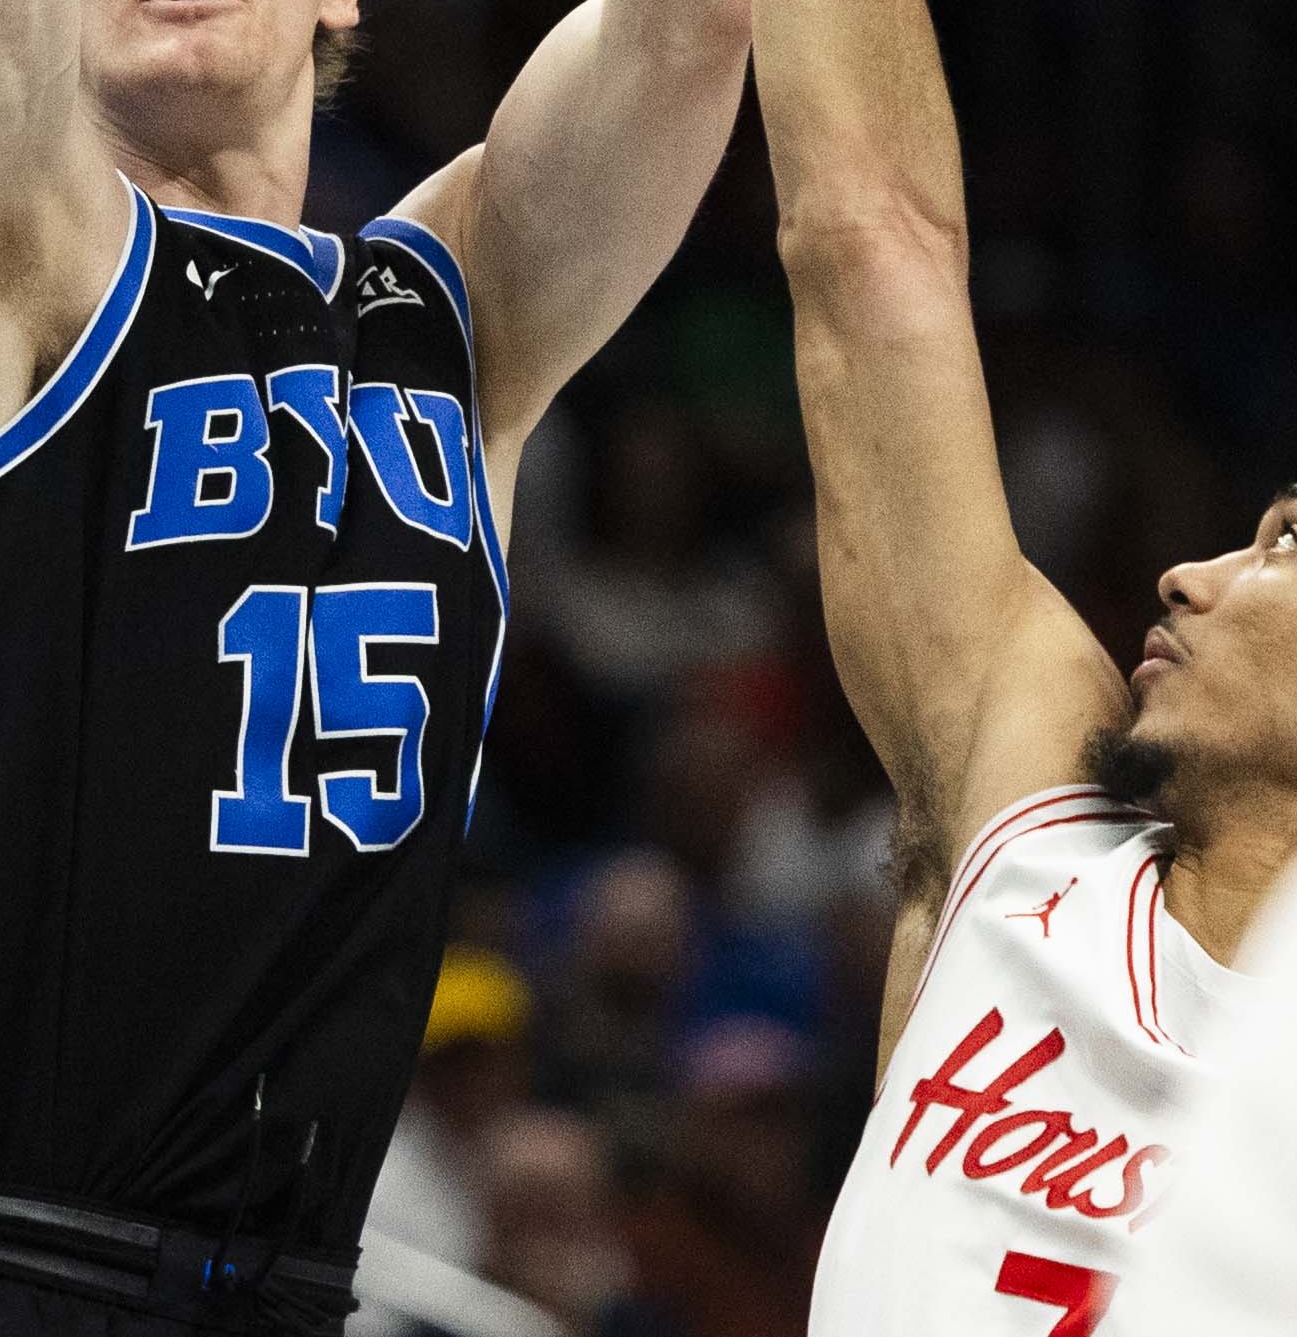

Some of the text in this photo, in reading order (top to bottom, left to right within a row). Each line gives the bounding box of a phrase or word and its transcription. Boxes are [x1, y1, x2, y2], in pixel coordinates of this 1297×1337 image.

[125, 364, 473, 552] BYU
[210, 583, 439, 857] 15
[890, 1006, 1178, 1236] Hous
